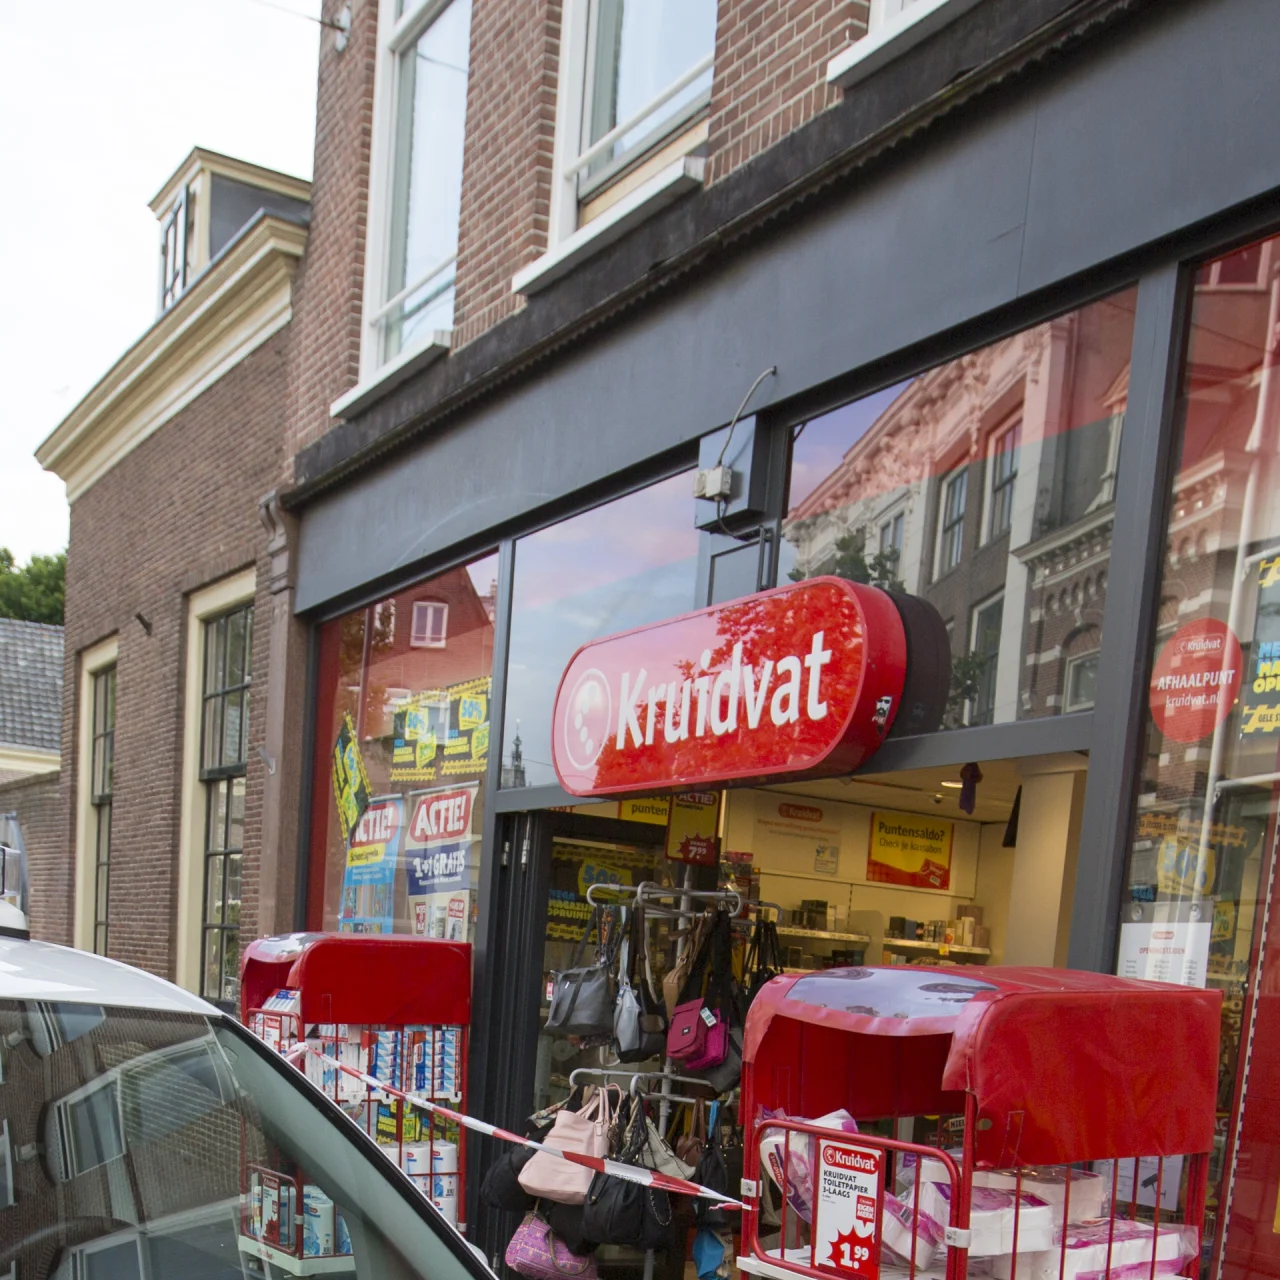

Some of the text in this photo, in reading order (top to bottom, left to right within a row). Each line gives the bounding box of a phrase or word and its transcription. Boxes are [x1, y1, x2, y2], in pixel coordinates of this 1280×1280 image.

[1188, 638, 1220, 651] Kruidvat
[1158, 670, 1235, 690] AFHAALPUNT
[616, 631, 832, 750] Kruidvat
[461, 700, 483, 720] 50%
[1258, 713, 1273, 722] GELE
[415, 795, 467, 837] ACTIE!
[878, 822, 945, 842] Puntensaldo?
[689, 846, 706, 859] 7.99
[879, 838, 899, 848] Check
[434, 850, 465, 874] GRATIS
[836, 1151, 875, 1170] Kruidvat
[824, 1170, 856, 1182] KRUIDVAT
[823, 1178, 868, 1194] TOILETPAPIER
[823, 1186, 850, 1198] 3-LAAGS
[840, 1242, 869, 1269] 1.99
